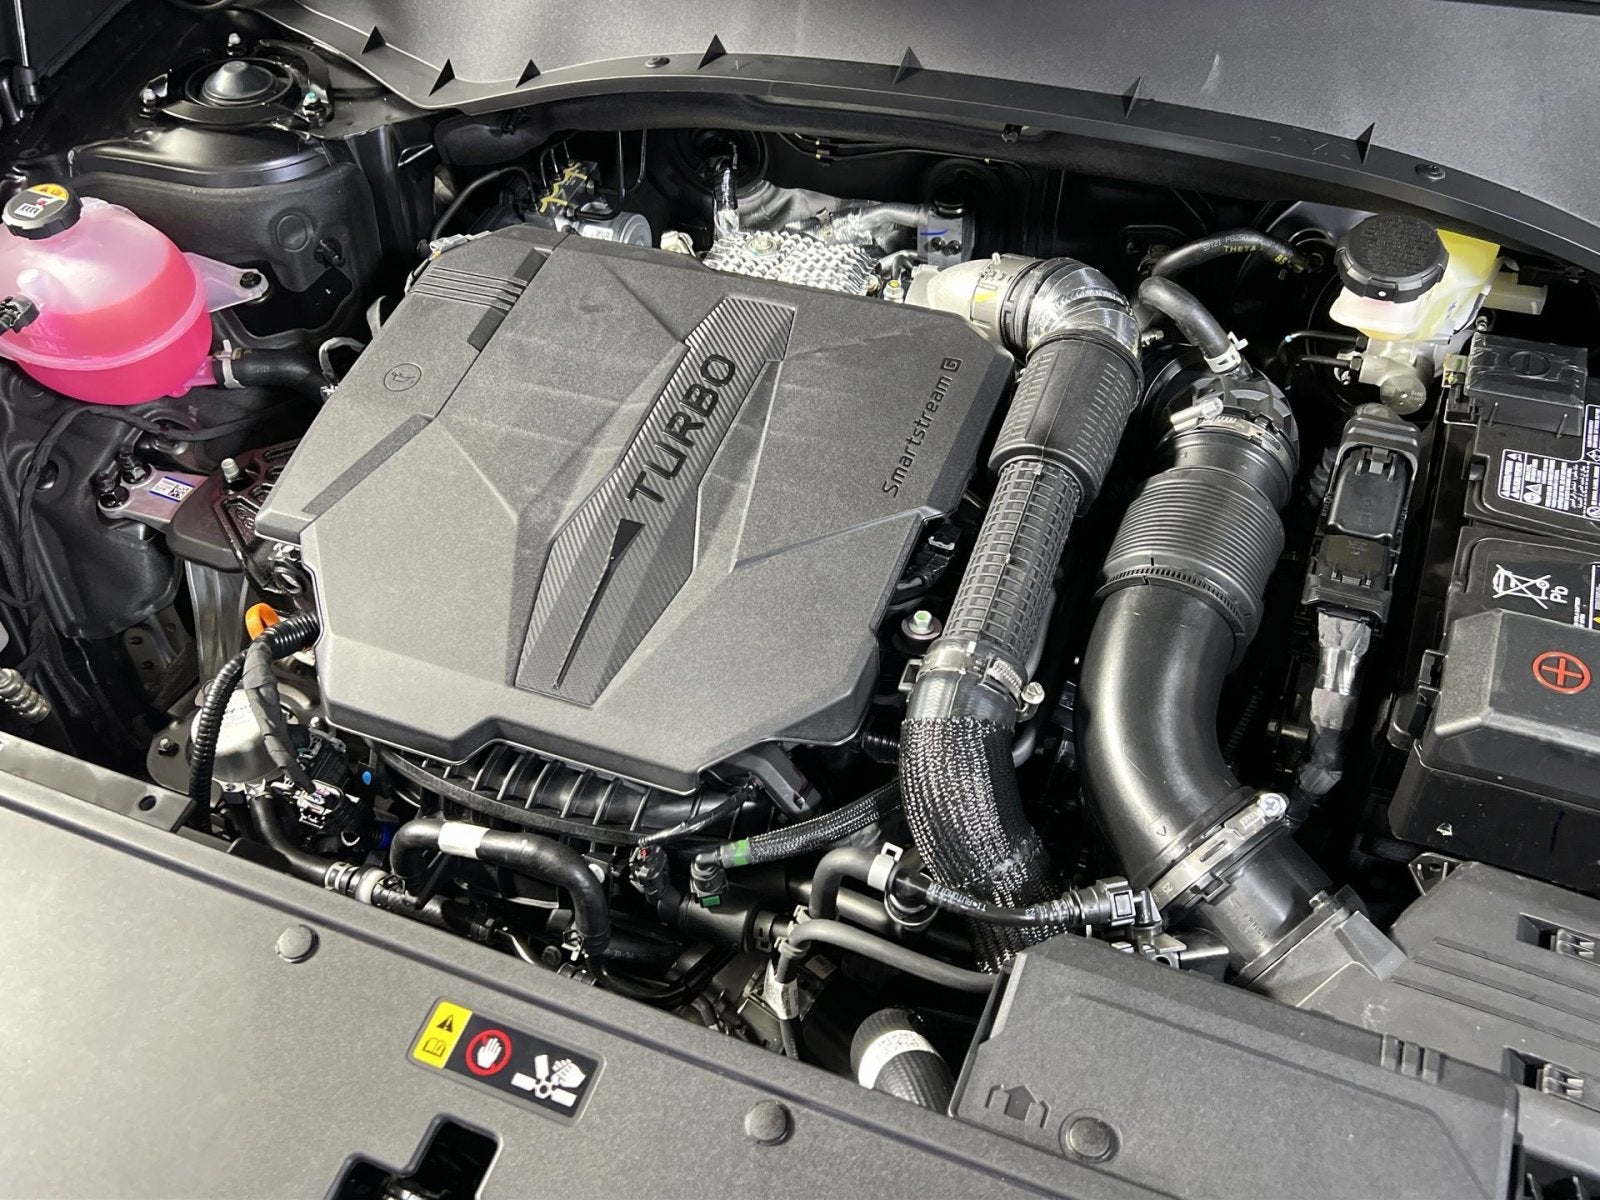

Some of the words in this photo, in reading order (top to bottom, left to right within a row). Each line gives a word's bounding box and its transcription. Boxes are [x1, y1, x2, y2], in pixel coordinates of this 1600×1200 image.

[1223, 245, 1257, 253] THETA
[625, 354, 736, 505] TURBO
[881, 375, 953, 498] Smartstream
[1549, 585, 1569, 604] Pb
